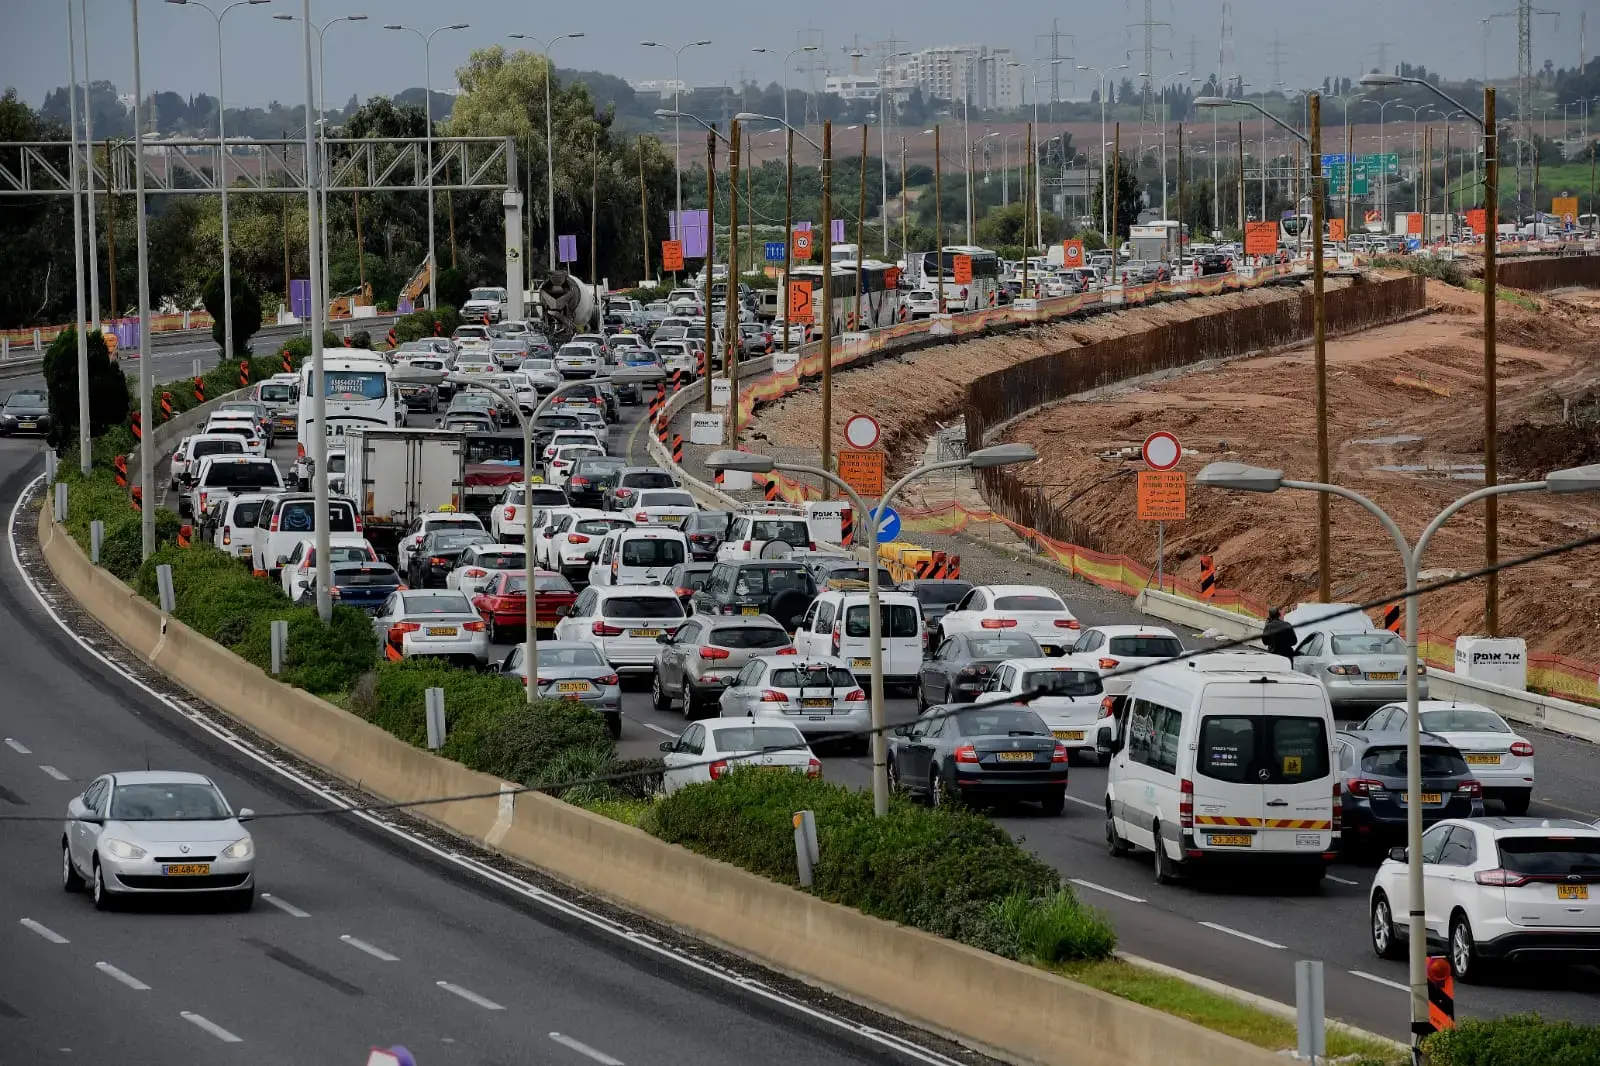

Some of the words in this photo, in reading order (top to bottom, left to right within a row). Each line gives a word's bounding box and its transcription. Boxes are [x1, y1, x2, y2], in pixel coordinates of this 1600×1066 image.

[812, 511, 833, 520] אופק
[1473, 652, 1502, 662] אופק
[1504, 652, 1521, 660] אר
